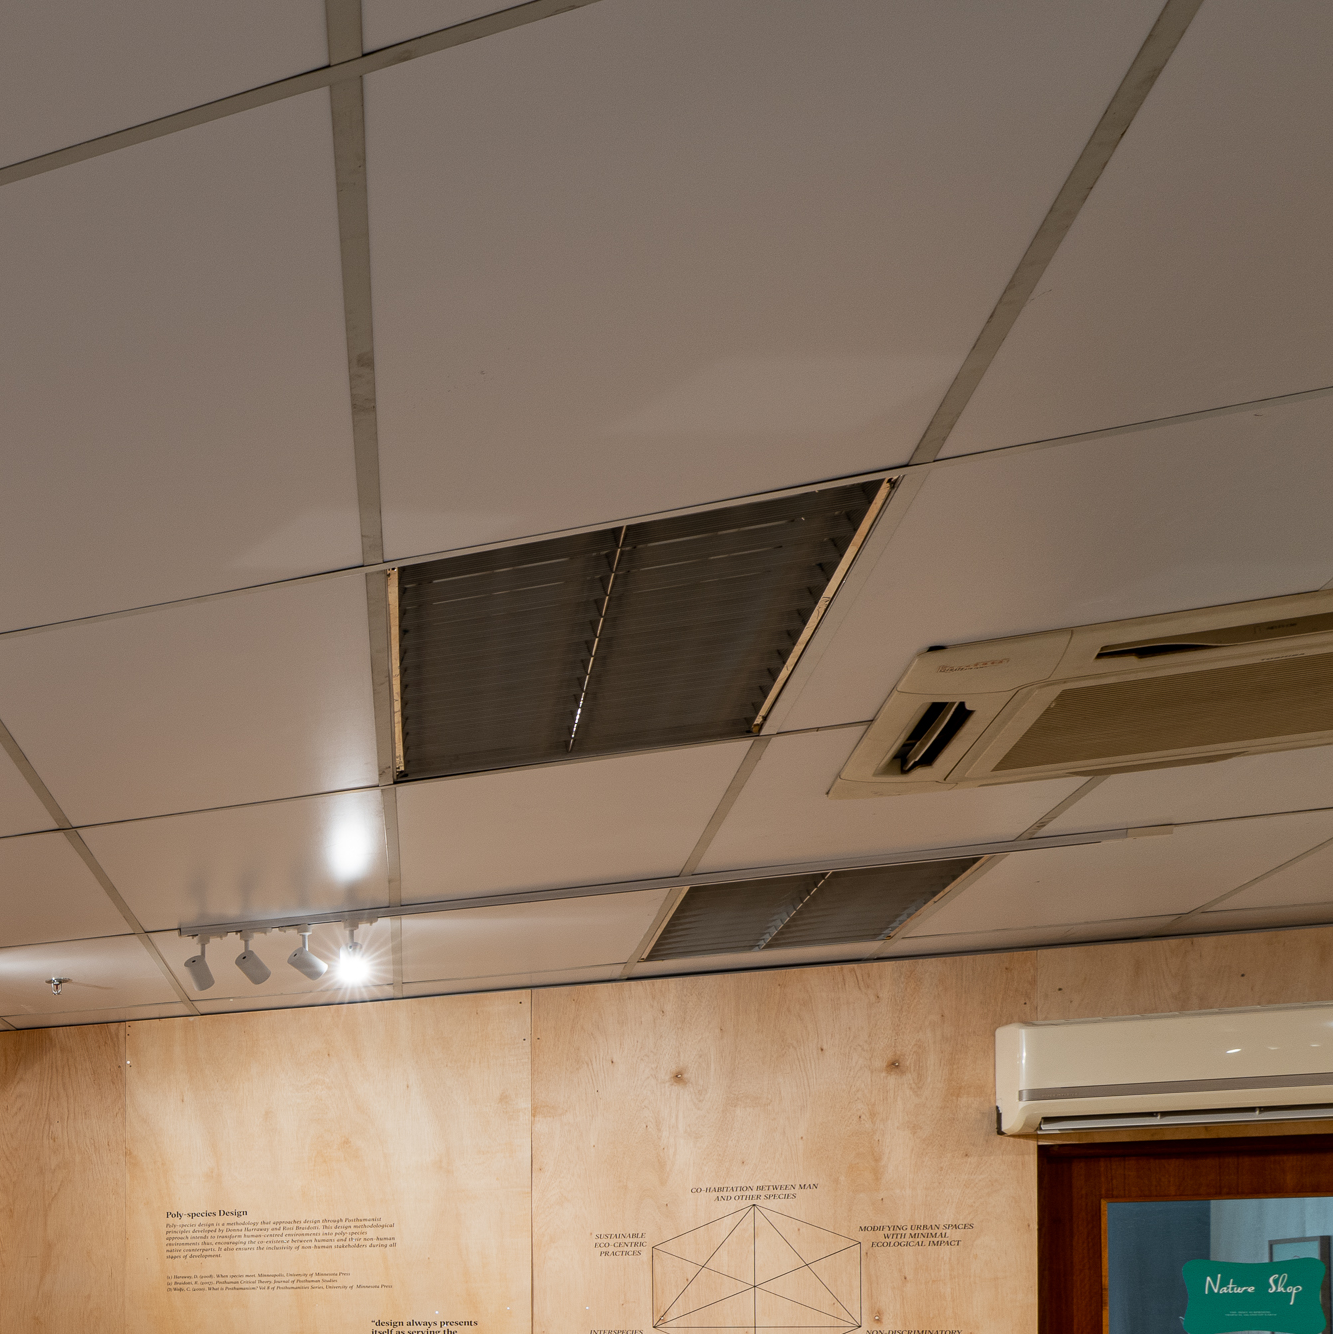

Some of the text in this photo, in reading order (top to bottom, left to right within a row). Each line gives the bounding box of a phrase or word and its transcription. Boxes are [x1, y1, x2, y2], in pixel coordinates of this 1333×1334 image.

[166, 1209, 248, 1220] Poly-species Design
[1205, 1273, 1302, 1305] Nature Shop
[406, 1319, 438, 1328] always
